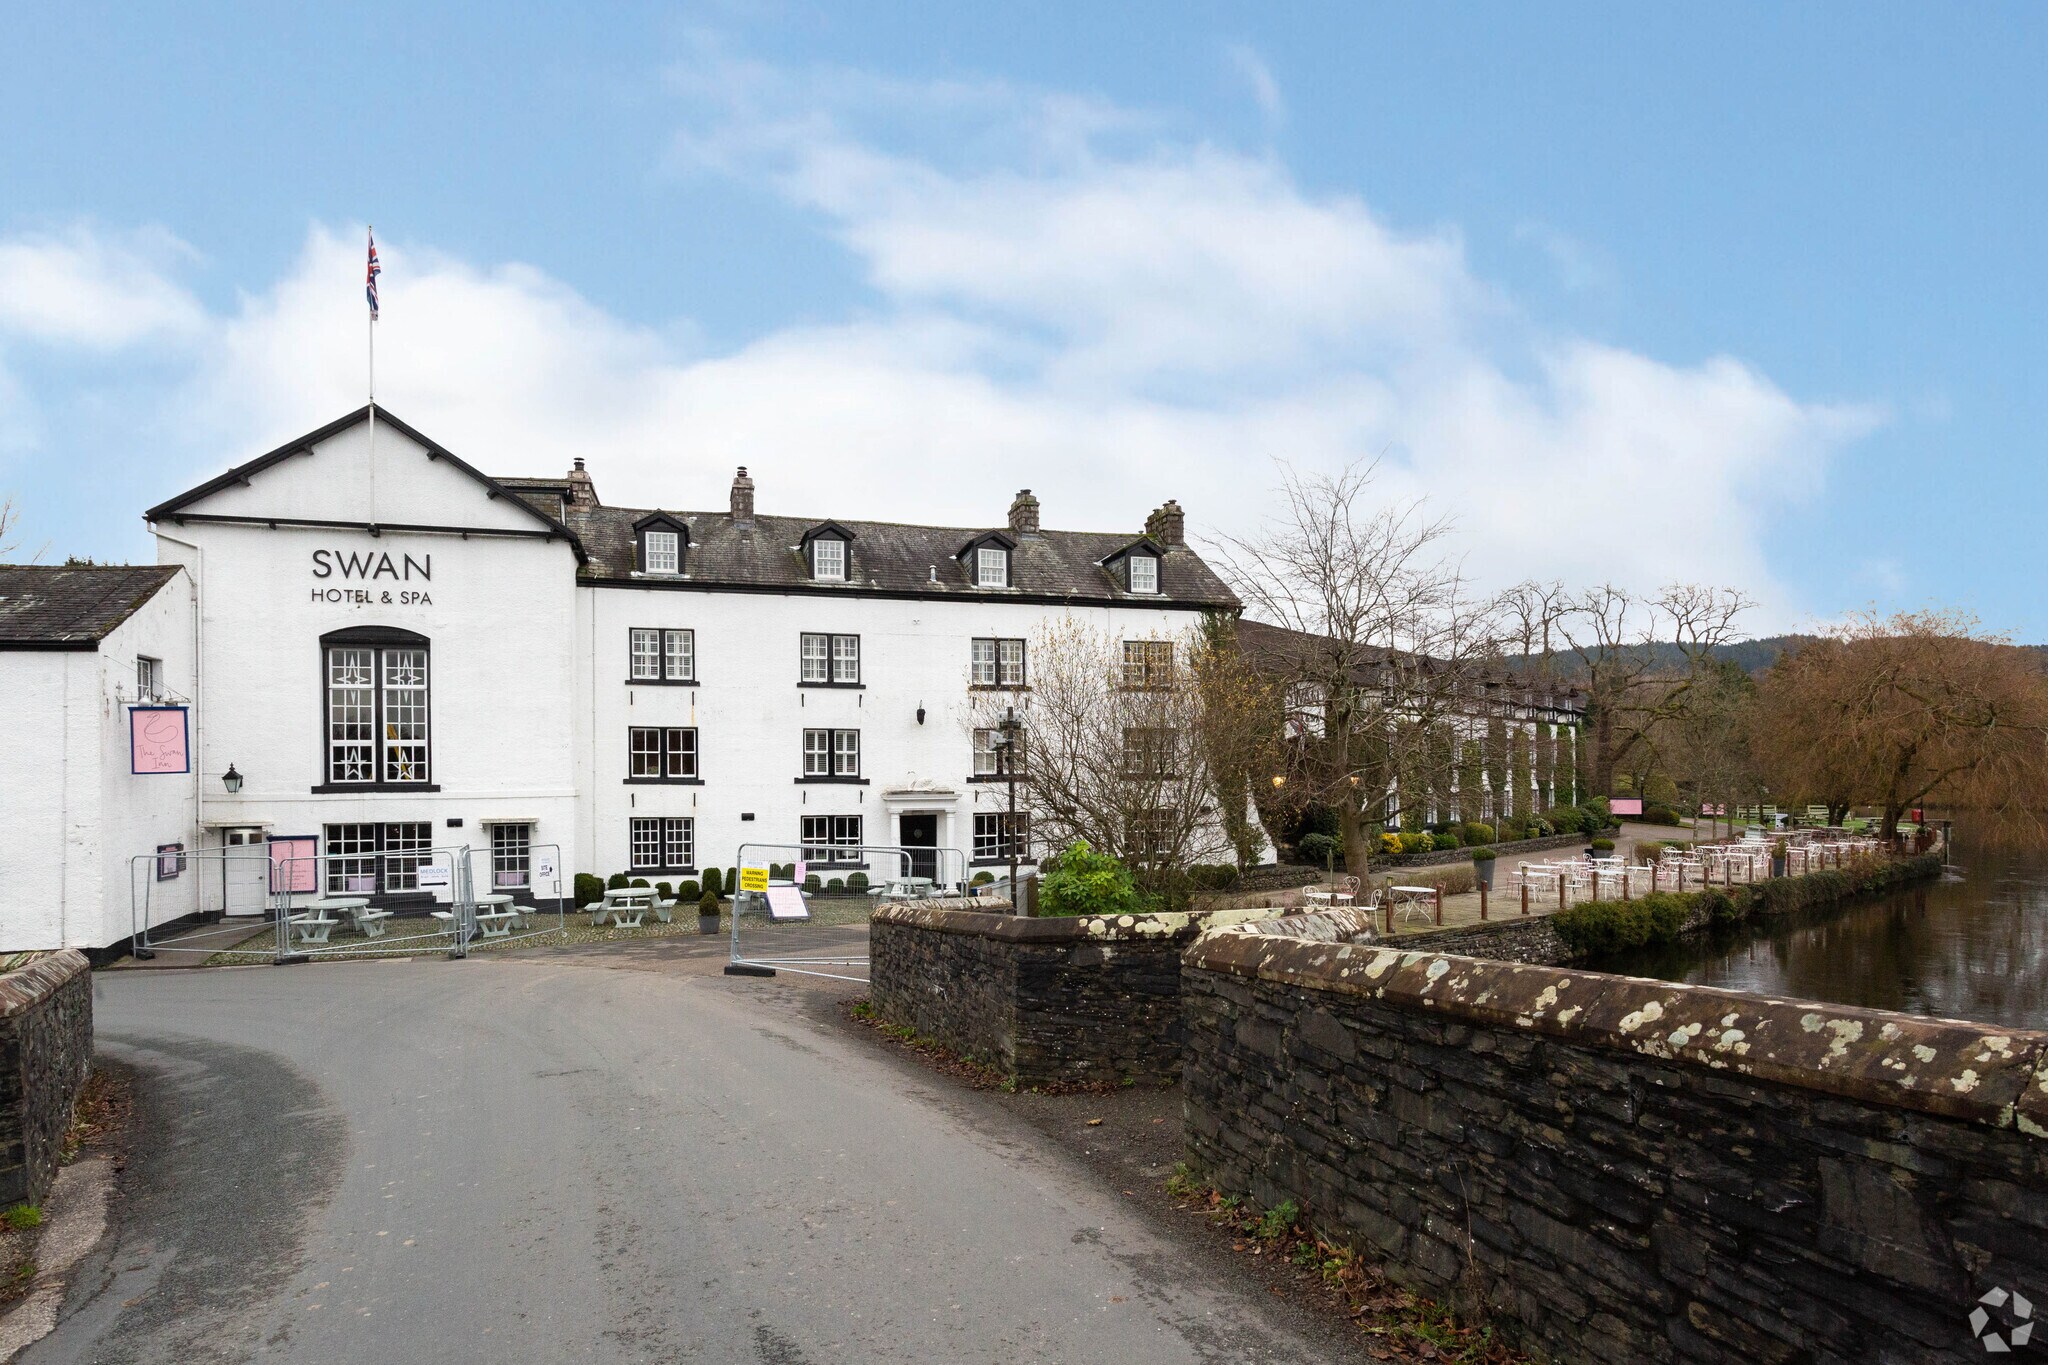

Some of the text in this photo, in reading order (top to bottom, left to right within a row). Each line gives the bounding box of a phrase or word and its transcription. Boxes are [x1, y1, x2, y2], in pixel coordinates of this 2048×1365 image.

[312, 549, 431, 582] SWAN
[311, 588, 433, 606] HOTEL & SPA
[136, 744, 184, 761] The Swan
[151, 757, 172, 770] Inn
